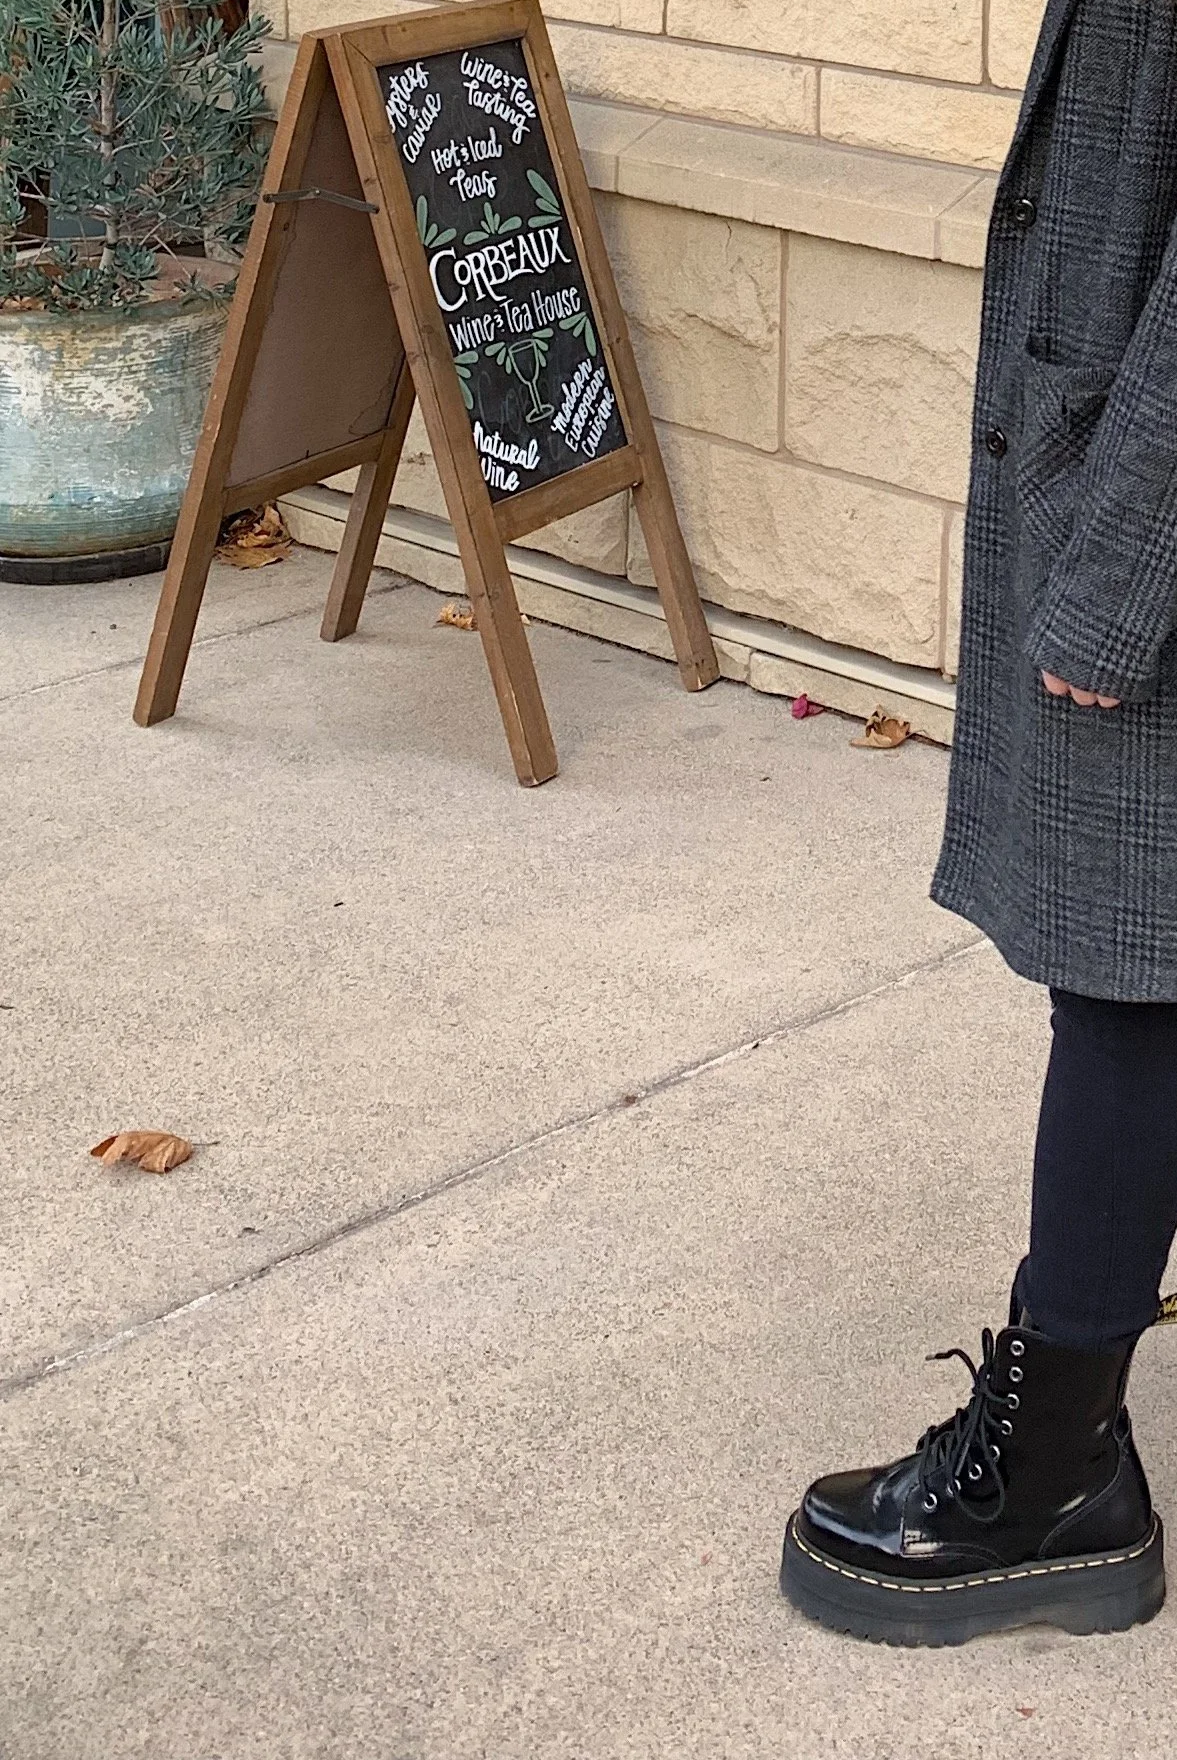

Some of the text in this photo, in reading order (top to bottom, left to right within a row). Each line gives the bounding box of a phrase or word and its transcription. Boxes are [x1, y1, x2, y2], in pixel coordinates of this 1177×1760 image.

[385, 61, 430, 133] ysters
[460, 51, 503, 90] Wine
[510, 75, 537, 118] Tea
[462, 79, 531, 145] Tasting
[430, 139, 461, 175] Hot
[467, 126, 503, 163] Iced
[448, 168, 498, 202] Teas
[428, 227, 572, 312] CORBEAUX
[448, 313, 495, 352] Wine
[499, 298, 535, 334] Tea
[530, 286, 581, 327] House
[565, 366, 606, 453] European
[581, 386, 615, 458] Cuisine
